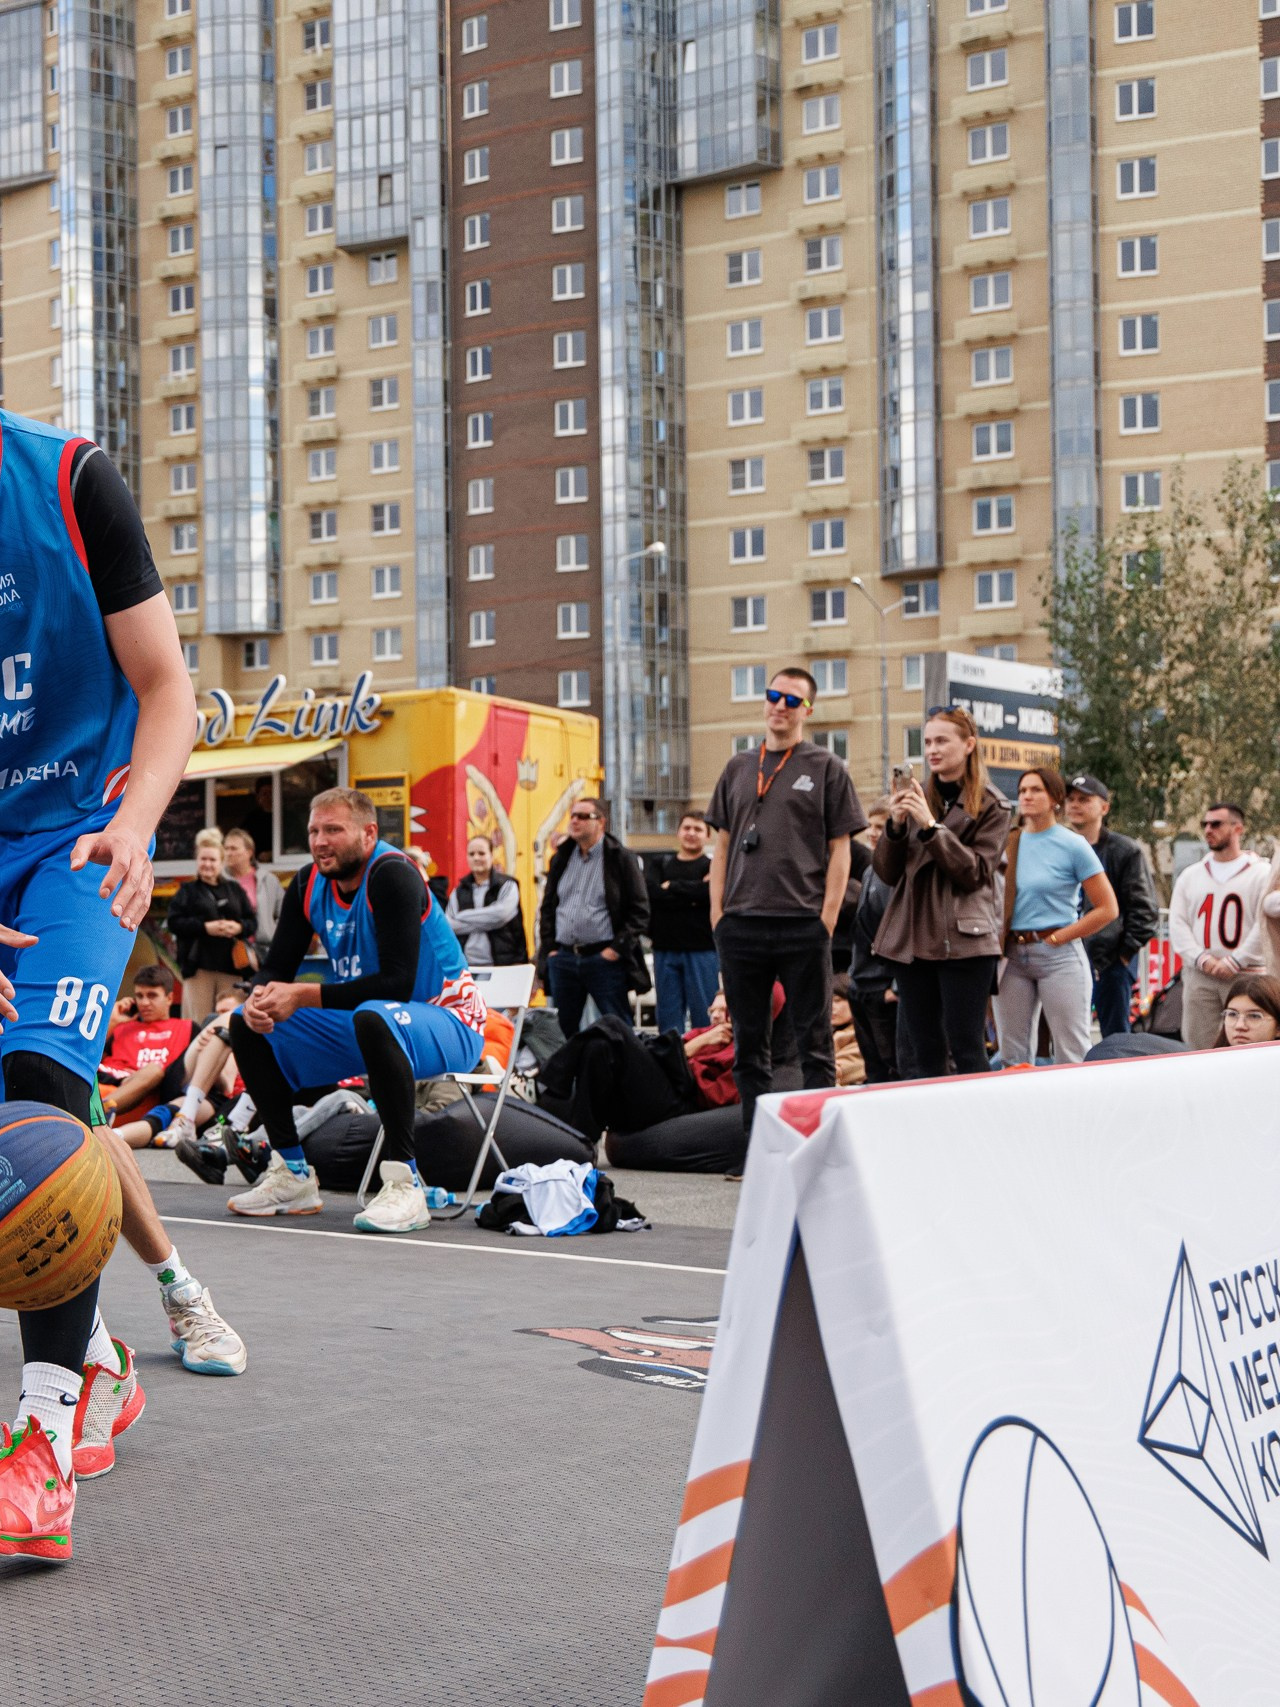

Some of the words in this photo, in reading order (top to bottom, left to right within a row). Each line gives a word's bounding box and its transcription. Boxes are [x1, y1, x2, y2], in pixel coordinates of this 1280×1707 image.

[244, 670, 383, 744] Link
[1197, 892, 1243, 950] 10
[48, 976, 109, 1041] 86
